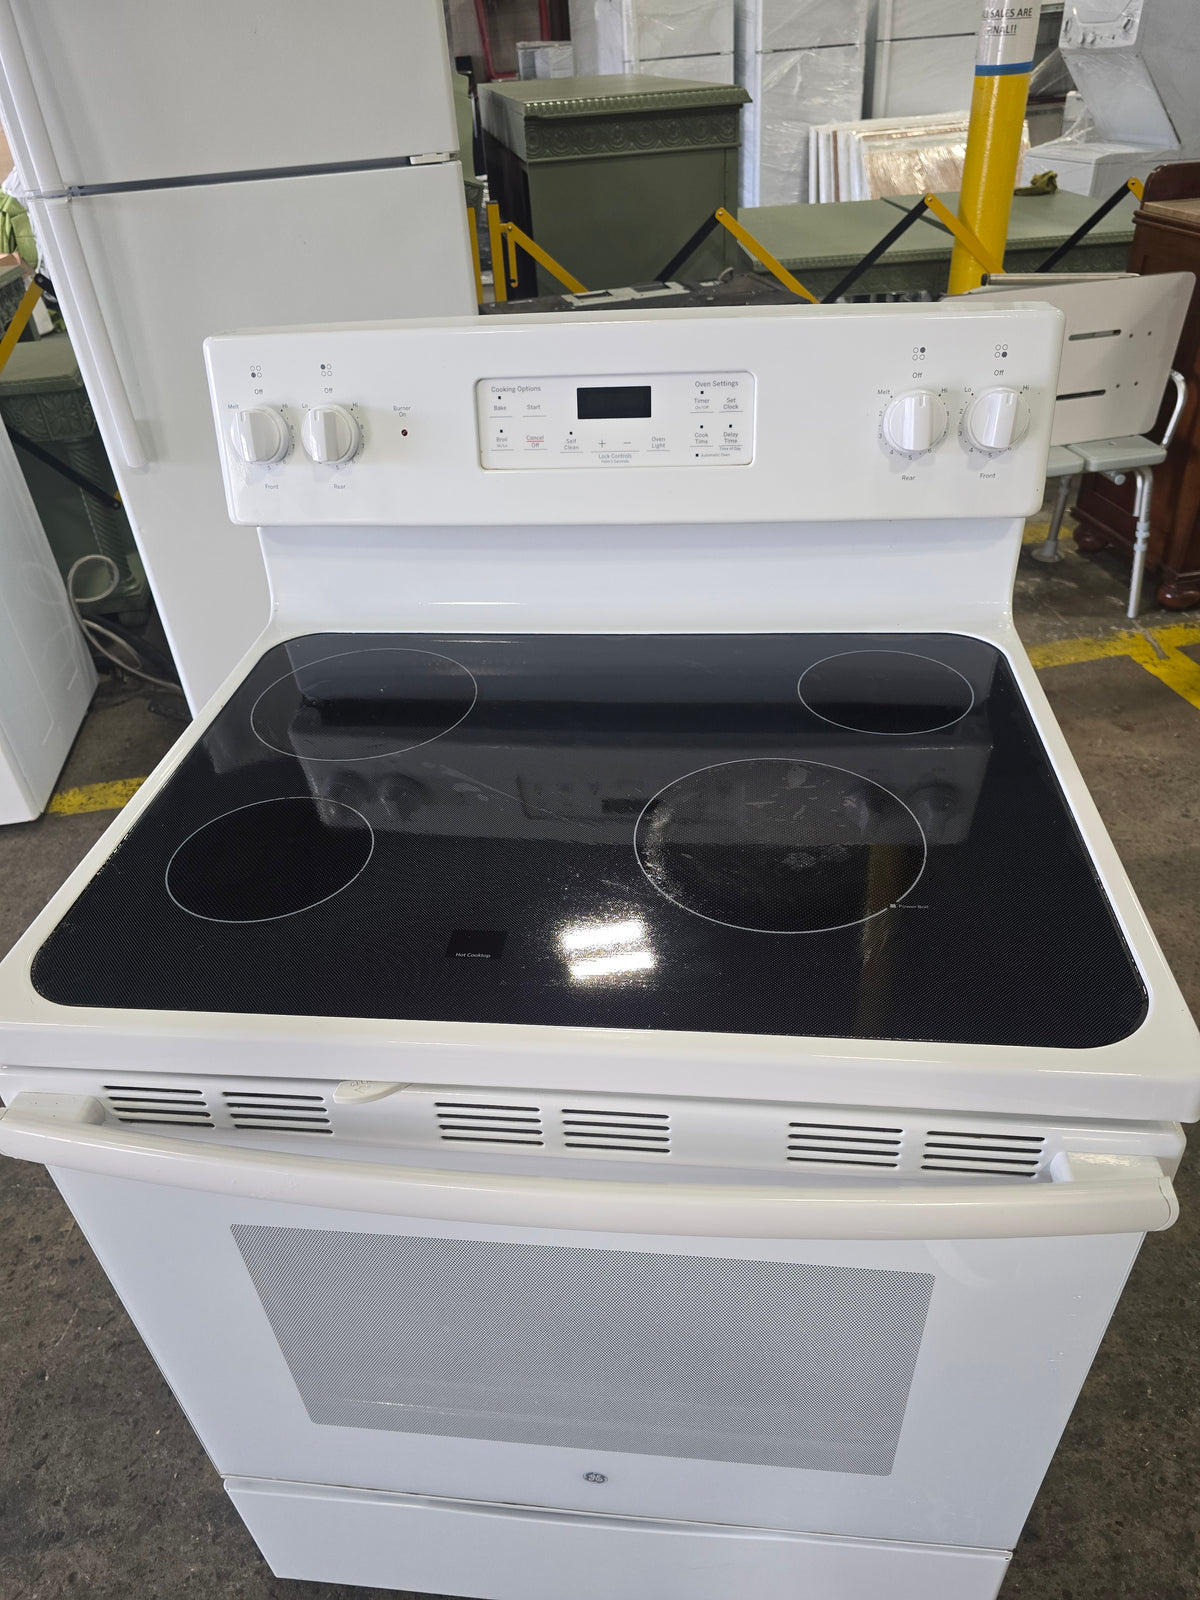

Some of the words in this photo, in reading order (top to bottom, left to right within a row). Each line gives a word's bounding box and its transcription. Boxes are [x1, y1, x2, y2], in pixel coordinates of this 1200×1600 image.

[990, 8, 1015, 18] SALES
[1017, 8, 1033, 17] ARE
[713, 380, 739, 388] Settings
[491, 386, 516, 394] Cooking
